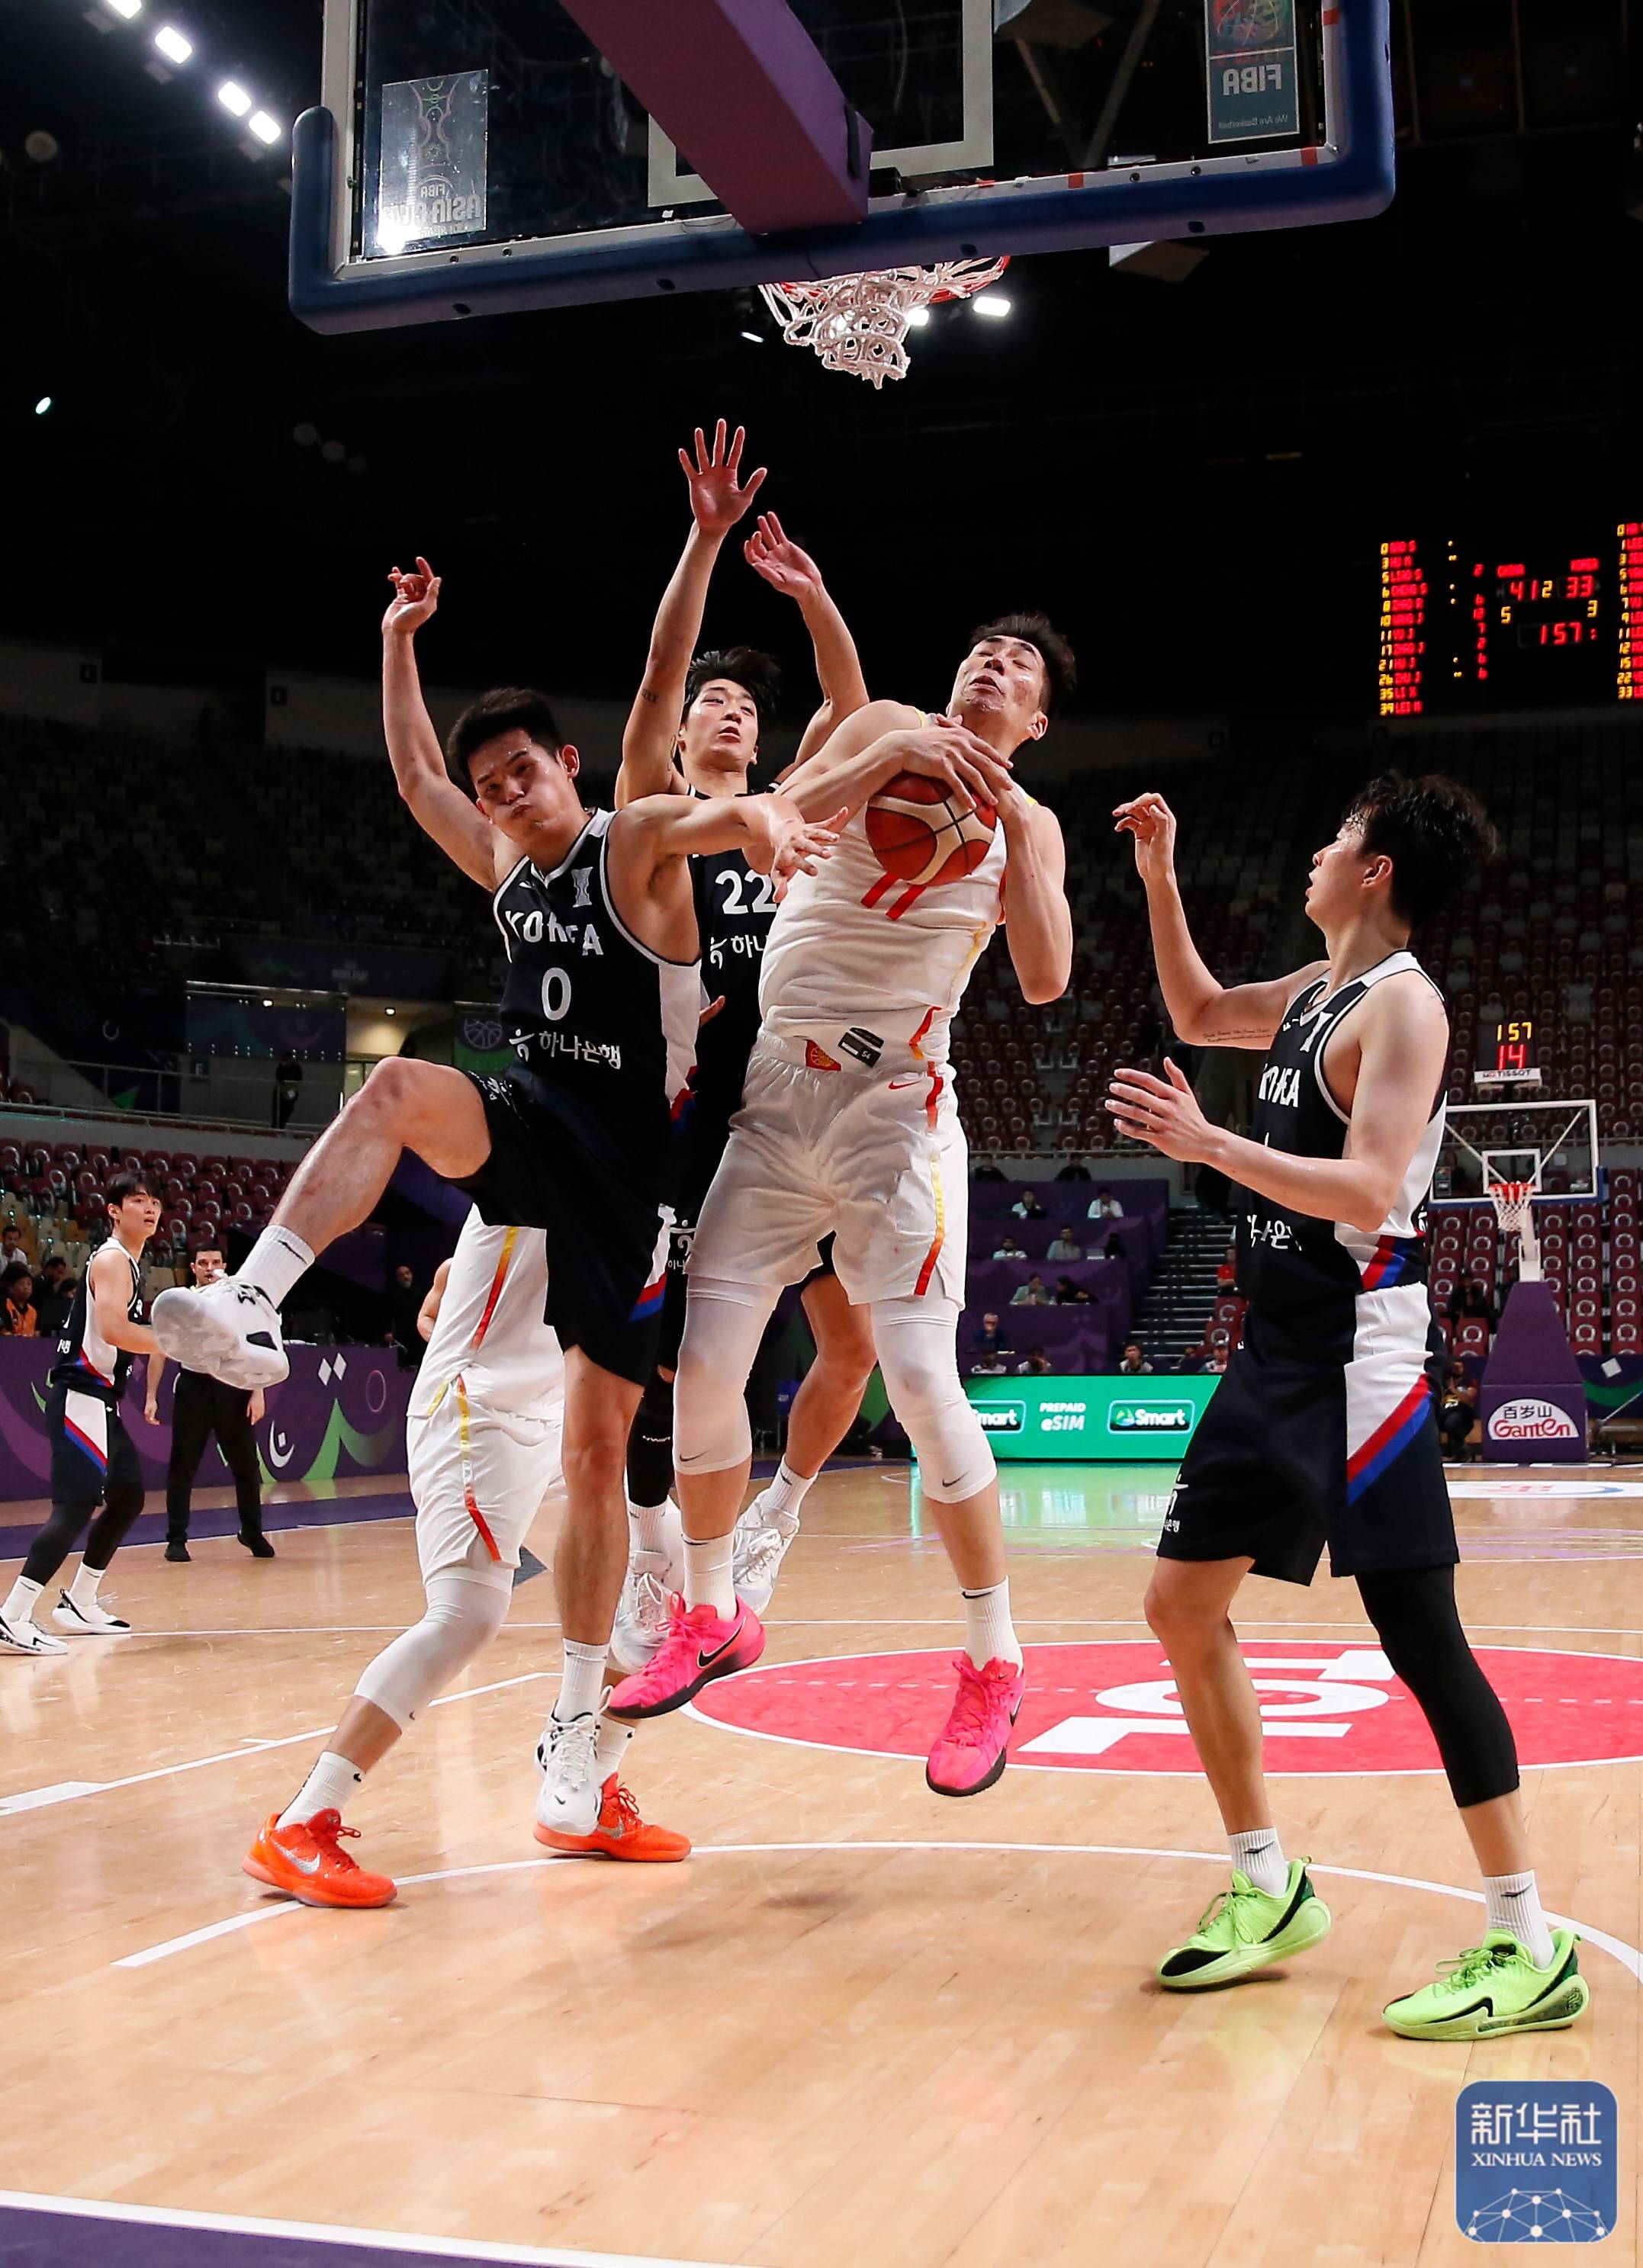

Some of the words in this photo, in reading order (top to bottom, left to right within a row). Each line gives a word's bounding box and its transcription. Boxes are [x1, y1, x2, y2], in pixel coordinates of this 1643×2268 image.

[1510, 580, 1539, 601] 41
[1542, 580, 1553, 598] 2
[1565, 575, 1594, 599] 33
[1500, 606, 1511, 624] 5
[1587, 599, 1598, 618] 3
[715, 869, 777, 915] 22
[541, 967, 572, 1021] 0
[539, 1030, 622, 1070] 하나은행
[1497, 1044, 1525, 1070] 14
[1497, 1068, 1532, 1078] TISSOT
[1039, 1402, 1087, 1412] PREPAID
[1503, 1405, 1552, 1419] 百岁山
[1040, 1415, 1085, 1431] eSIM
[1134, 1409, 1186, 1426] Smart
[1494, 1418, 1571, 1438] Ganten
